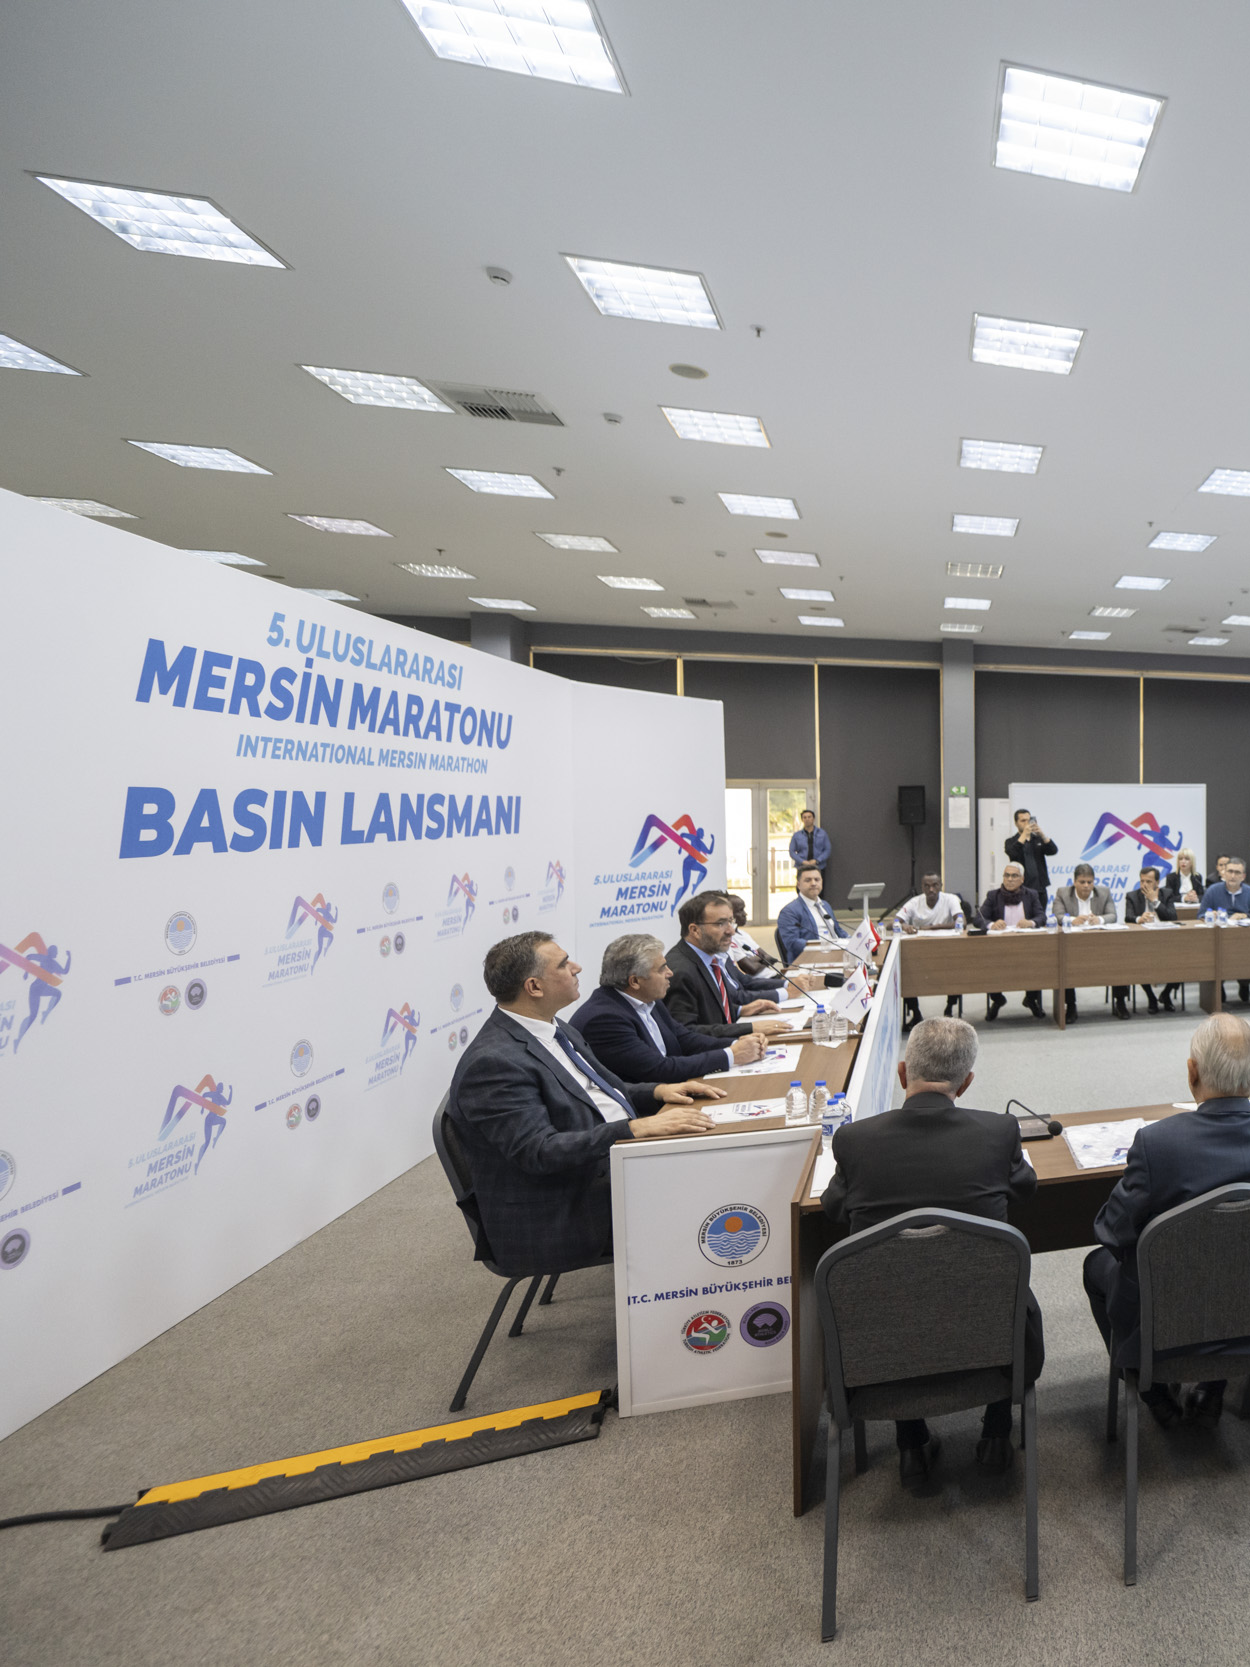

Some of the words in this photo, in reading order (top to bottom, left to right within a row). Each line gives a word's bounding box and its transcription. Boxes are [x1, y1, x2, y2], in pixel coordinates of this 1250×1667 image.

[135, 638, 344, 728] MERSİN
[347, 682, 513, 750] MARATONU
[236, 734, 375, 766] INTERNATIONAL
[377, 748, 428, 770] MERSIN
[429, 754, 488, 774] MARATHON
[119, 786, 327, 859] BASIN
[340, 791, 521, 845] LANSMANI
[616, 881, 671, 901] MERSİN
[600, 900, 667, 919] MARATONU
[277, 947, 311, 966] MERSİN
[268, 963, 309, 981] MARATONU
[147, 1144, 195, 1177] MERSİN
[133, 1161, 192, 1198] MARATONU
[654, 1287, 698, 1302] MERSİN
[702, 1277, 773, 1295] BÜYÜKŞEHİR
